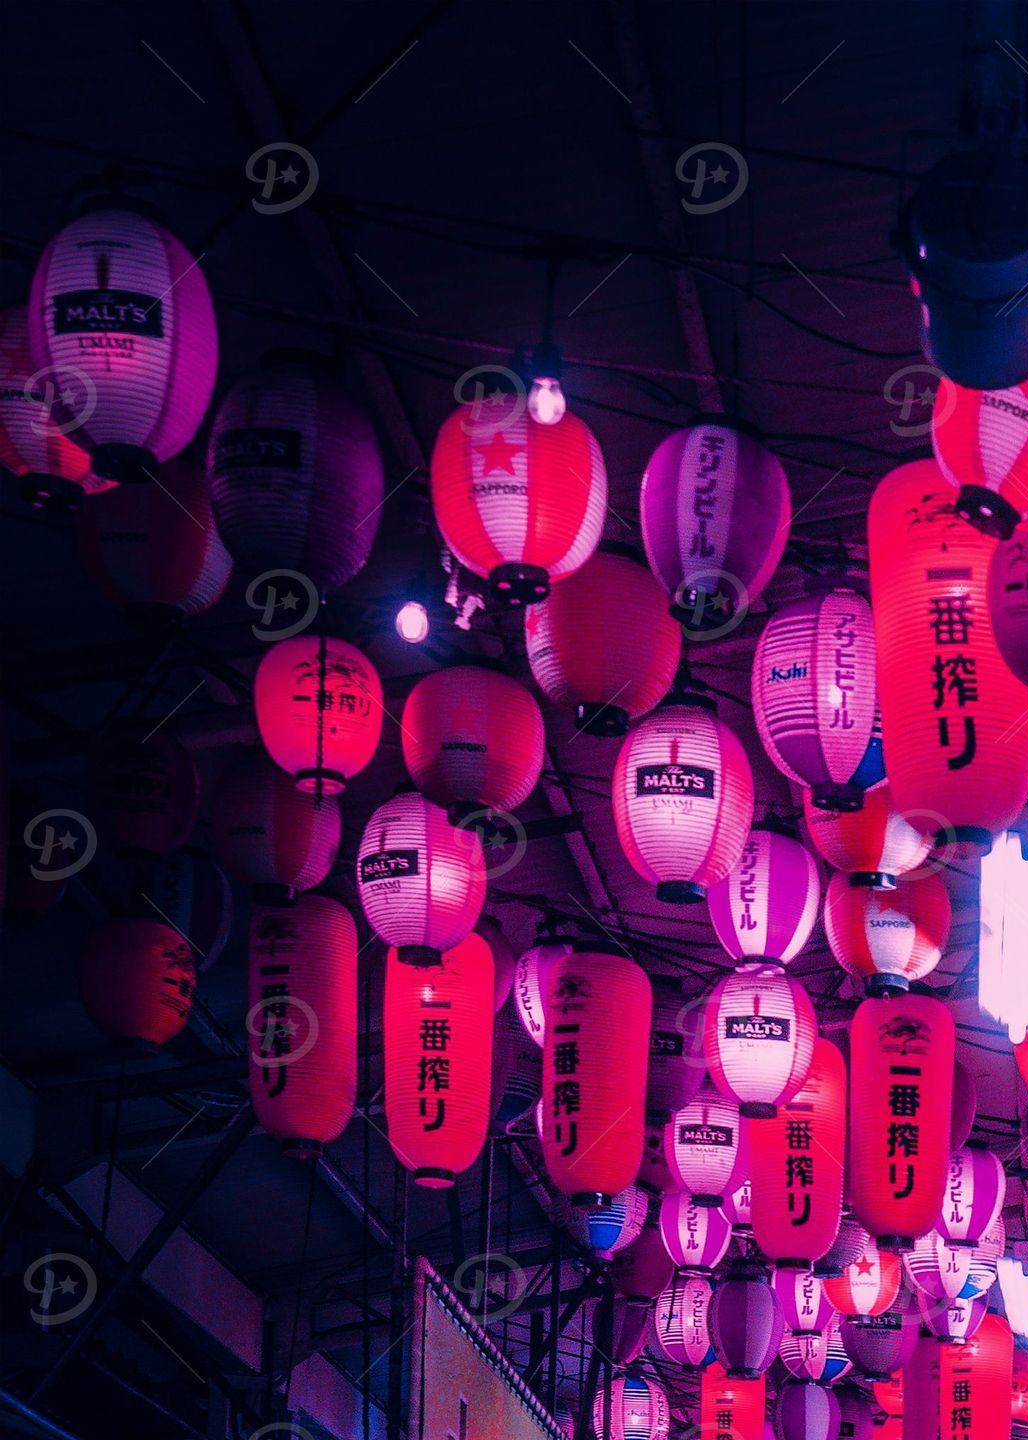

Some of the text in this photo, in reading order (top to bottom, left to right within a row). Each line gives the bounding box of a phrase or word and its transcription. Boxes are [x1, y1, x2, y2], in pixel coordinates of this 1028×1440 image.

[66, 301, 147, 323] MALT'S
[471, 484, 528, 497] SAPPORO
[829, 613, 856, 730] アサヒビール
[926, 567, 979, 771] 一番搾り
[643, 773, 706, 790] MALT'S
[364, 857, 410, 876] MALT'S
[739, 841, 760, 931] キリンビール
[869, 919, 912, 930] SAPPORO
[732, 1022, 783, 1036] MALT'S
[418, 1002, 451, 1132] 一番搾り
[553, 1024, 581, 1157] 一番搾り
[684, 1129, 726, 1142] MALT'S
[887, 1065, 922, 1200] 一番搾り
[785, 1103, 815, 1227] 一番搾り
[949, 1154, 965, 1224] キリンビール
[691, 1289, 705, 1345] アサヒビール
